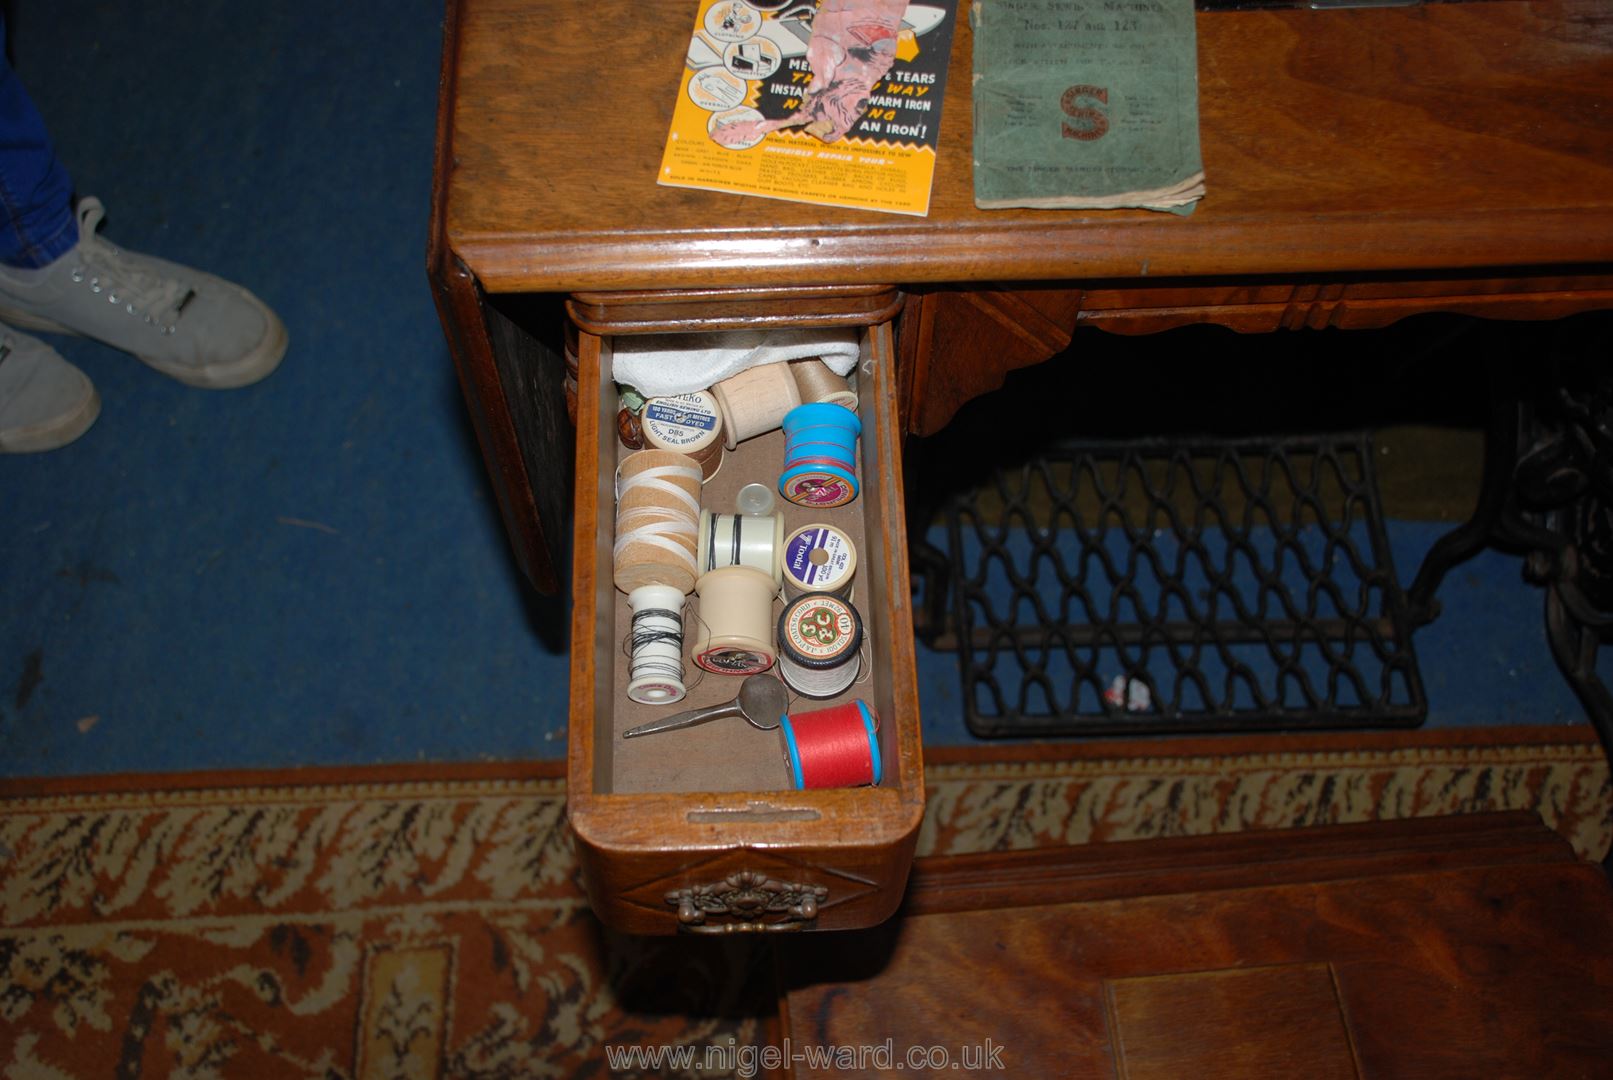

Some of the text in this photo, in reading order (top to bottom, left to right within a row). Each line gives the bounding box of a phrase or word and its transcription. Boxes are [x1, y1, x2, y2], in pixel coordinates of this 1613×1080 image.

[789, 59, 812, 72] ME
[896, 71, 936, 84] TEARS
[770, 83, 931, 112] INSTA WARM IRON
[887, 83, 928, 97] WAY
[860, 121, 928, 139] AN IRON!
[656, 413, 704, 428] FAST DYED
[650, 420, 705, 444] LIGHT SEAL BROWN
[794, 545, 808, 570] Tootal
[840, 618, 850, 630] 40
